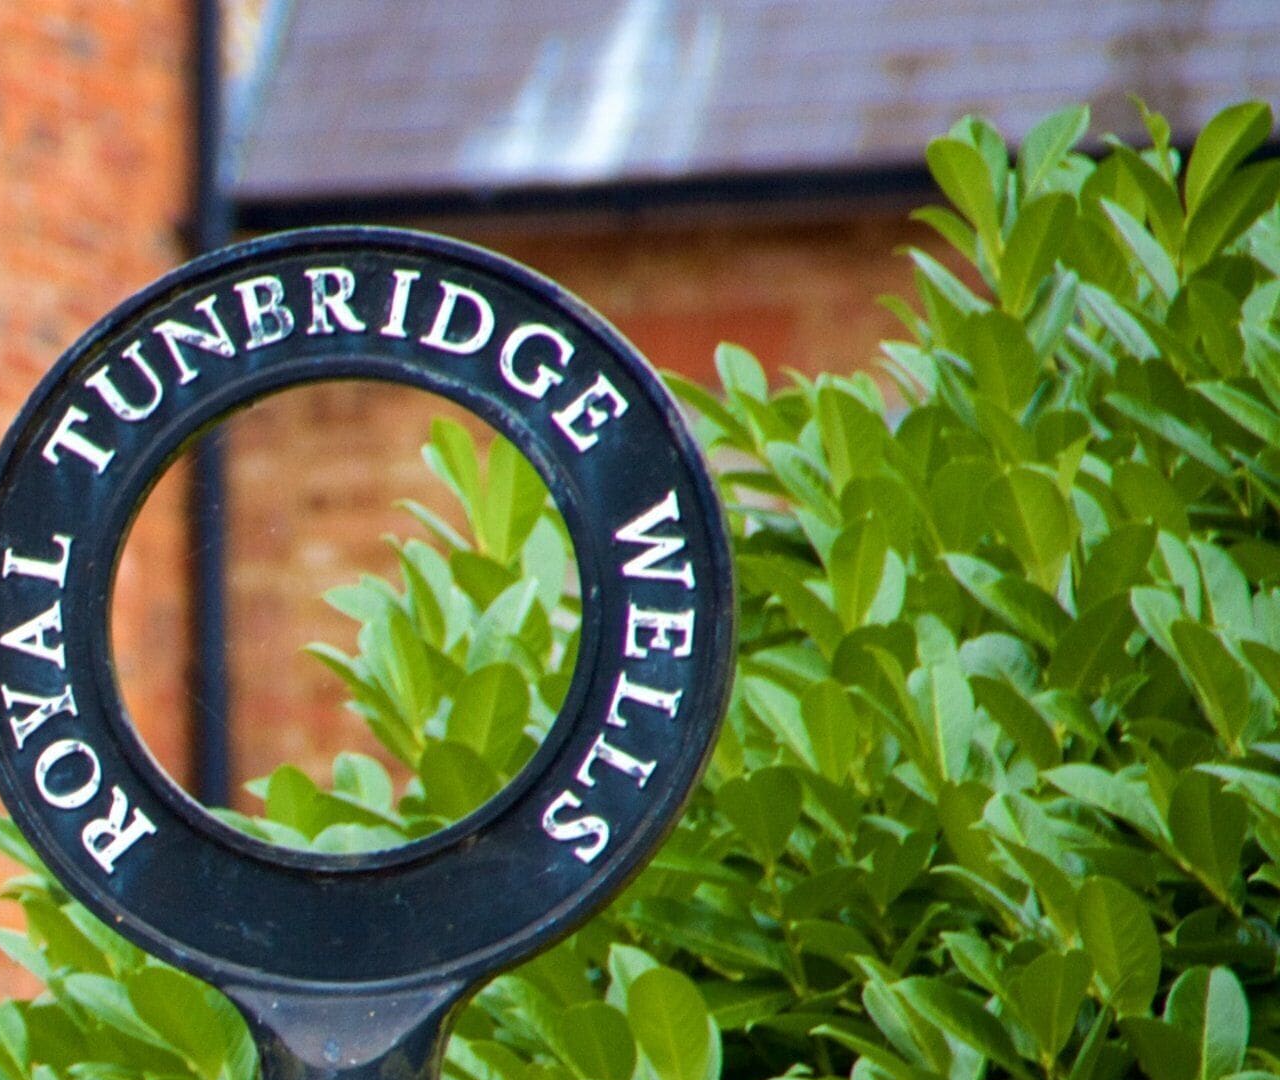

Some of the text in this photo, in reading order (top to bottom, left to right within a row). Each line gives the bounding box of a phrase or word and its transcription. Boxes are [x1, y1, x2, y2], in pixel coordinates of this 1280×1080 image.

[0, 266, 696, 875] ROYAL TUNBRIDGE WELLS
